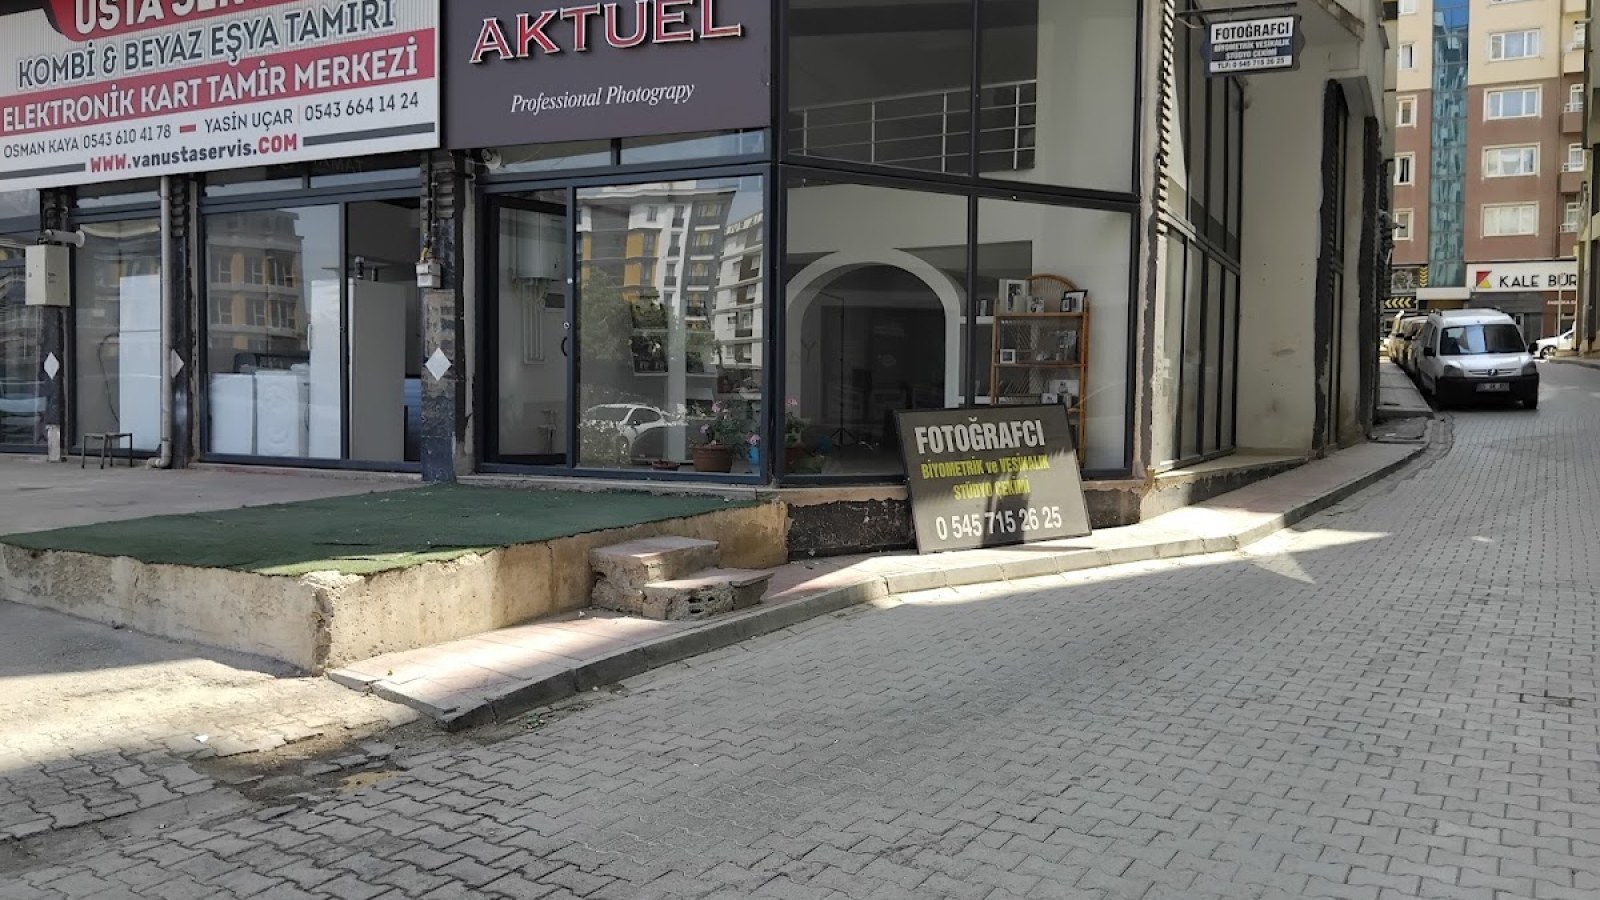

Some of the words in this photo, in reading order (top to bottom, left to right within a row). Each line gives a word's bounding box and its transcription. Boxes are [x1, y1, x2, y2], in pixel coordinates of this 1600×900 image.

[1215, 22, 1289, 41] FOTOĞRAFCI
[19, 41, 96, 88] KOMBİ
[102, 46, 117, 74] &
[125, 30, 202, 71] BEYAZ
[211, 17, 279, 63] EŞYA
[3, 84, 135, 132] ELEKTRONİK
[141, 78, 201, 113] KART
[206, 60, 286, 102] TAMİR
[294, 36, 418, 91] MERKEZİ
[510, 88, 603, 116] Professional
[605, 84, 695, 106] Photograpy
[4, 141, 45, 159] OSMAN
[49, 136, 79, 154] KAYA
[83, 131, 112, 149] 0543
[115, 127, 137, 145] 610
[139, 125, 153, 141] 41
[156, 123, 171, 139] 78
[204, 112, 248, 135] YASİN
[252, 108, 293, 132] UÇAR
[304, 100, 341, 121] 0543
[346, 97, 374, 116] 664
[379, 94, 395, 112] 14
[400, 91, 419, 110] 24
[1500, 275, 1539, 288] KALE
[914, 416, 1045, 454] FOTOĞRAFCI
[921, 455, 984, 480] BİYOMETRİK
[985, 461, 998, 474] ve
[999, 453, 1050, 473] VESİKALIK
[953, 481, 992, 500] STÜDYO
[935, 516, 948, 540] 0
[951, 514, 982, 538] 545
[985, 510, 1016, 534] 715
[1018, 508, 1039, 531] 26
[1042, 506, 1062, 529] 25
